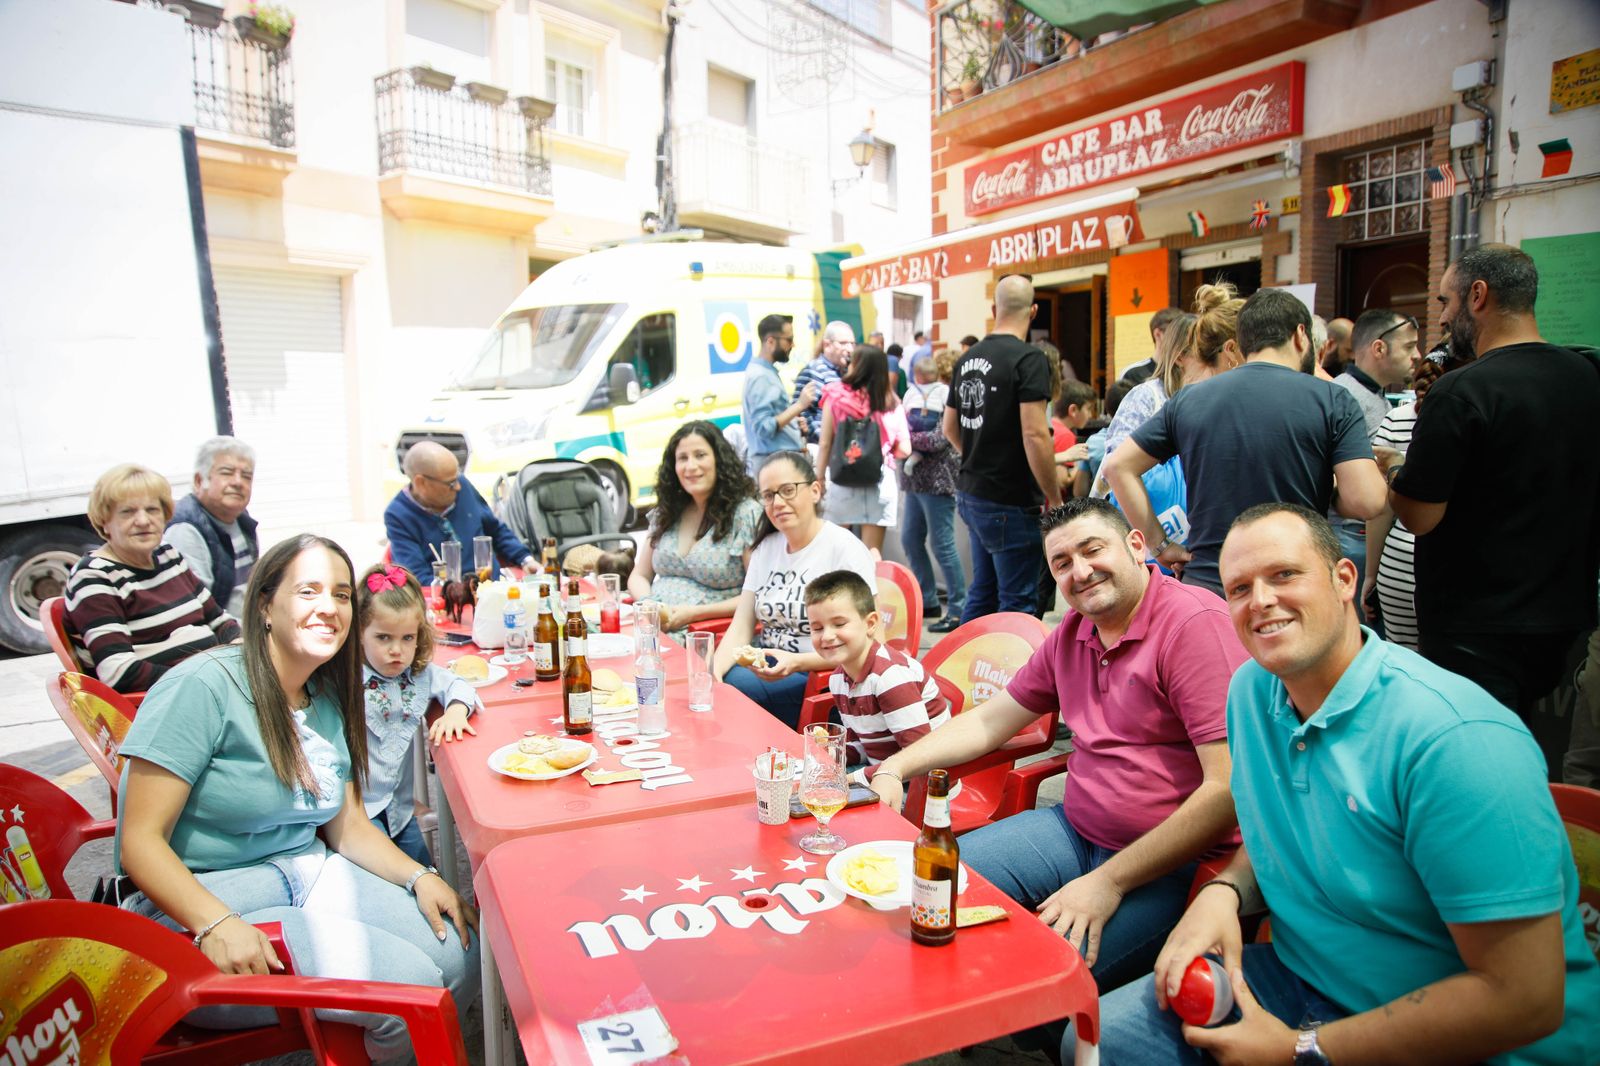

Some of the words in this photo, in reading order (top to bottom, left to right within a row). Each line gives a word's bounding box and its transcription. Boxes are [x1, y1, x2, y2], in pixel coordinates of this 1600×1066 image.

[1041, 127, 1100, 166] CAFE
[1108, 110, 1164, 148] BAR
[1180, 83, 1276, 144] Coca-Cola
[1034, 137, 1169, 197] ABRUPLAZ
[597, 1022, 645, 1054] 27
